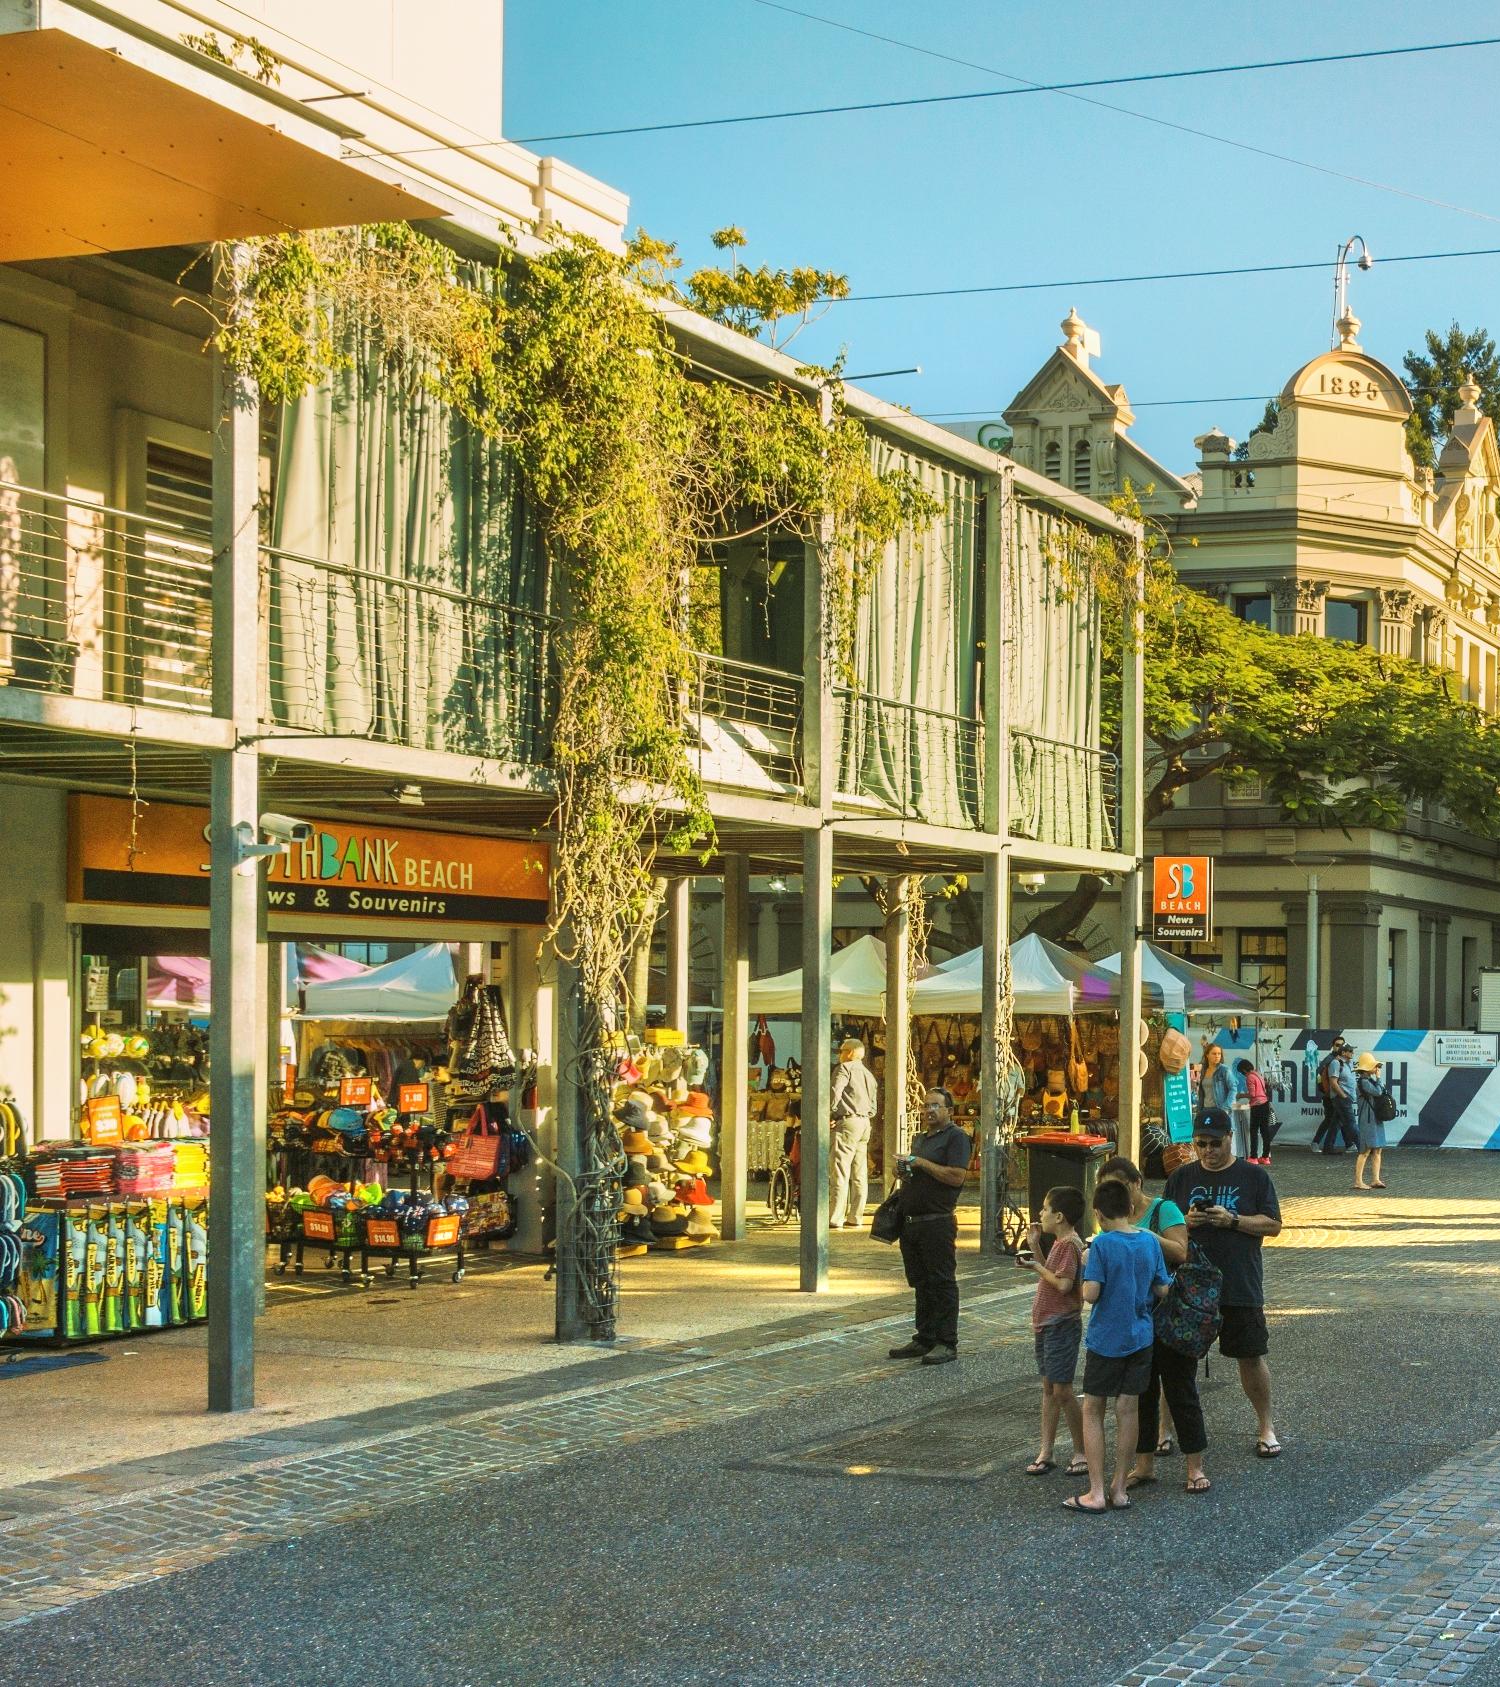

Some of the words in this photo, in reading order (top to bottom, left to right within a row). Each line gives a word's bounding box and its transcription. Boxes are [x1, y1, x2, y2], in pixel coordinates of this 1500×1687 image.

[1320, 374, 1379, 401] 1885
[405, 857, 473, 890] BEACH
[314, 888, 330, 908] &
[349, 891, 446, 914] Souvenirs
[1160, 901, 1201, 911] BEACH
[1167, 915, 1194, 924] News
[1157, 927, 1204, 937] Souvenirs
